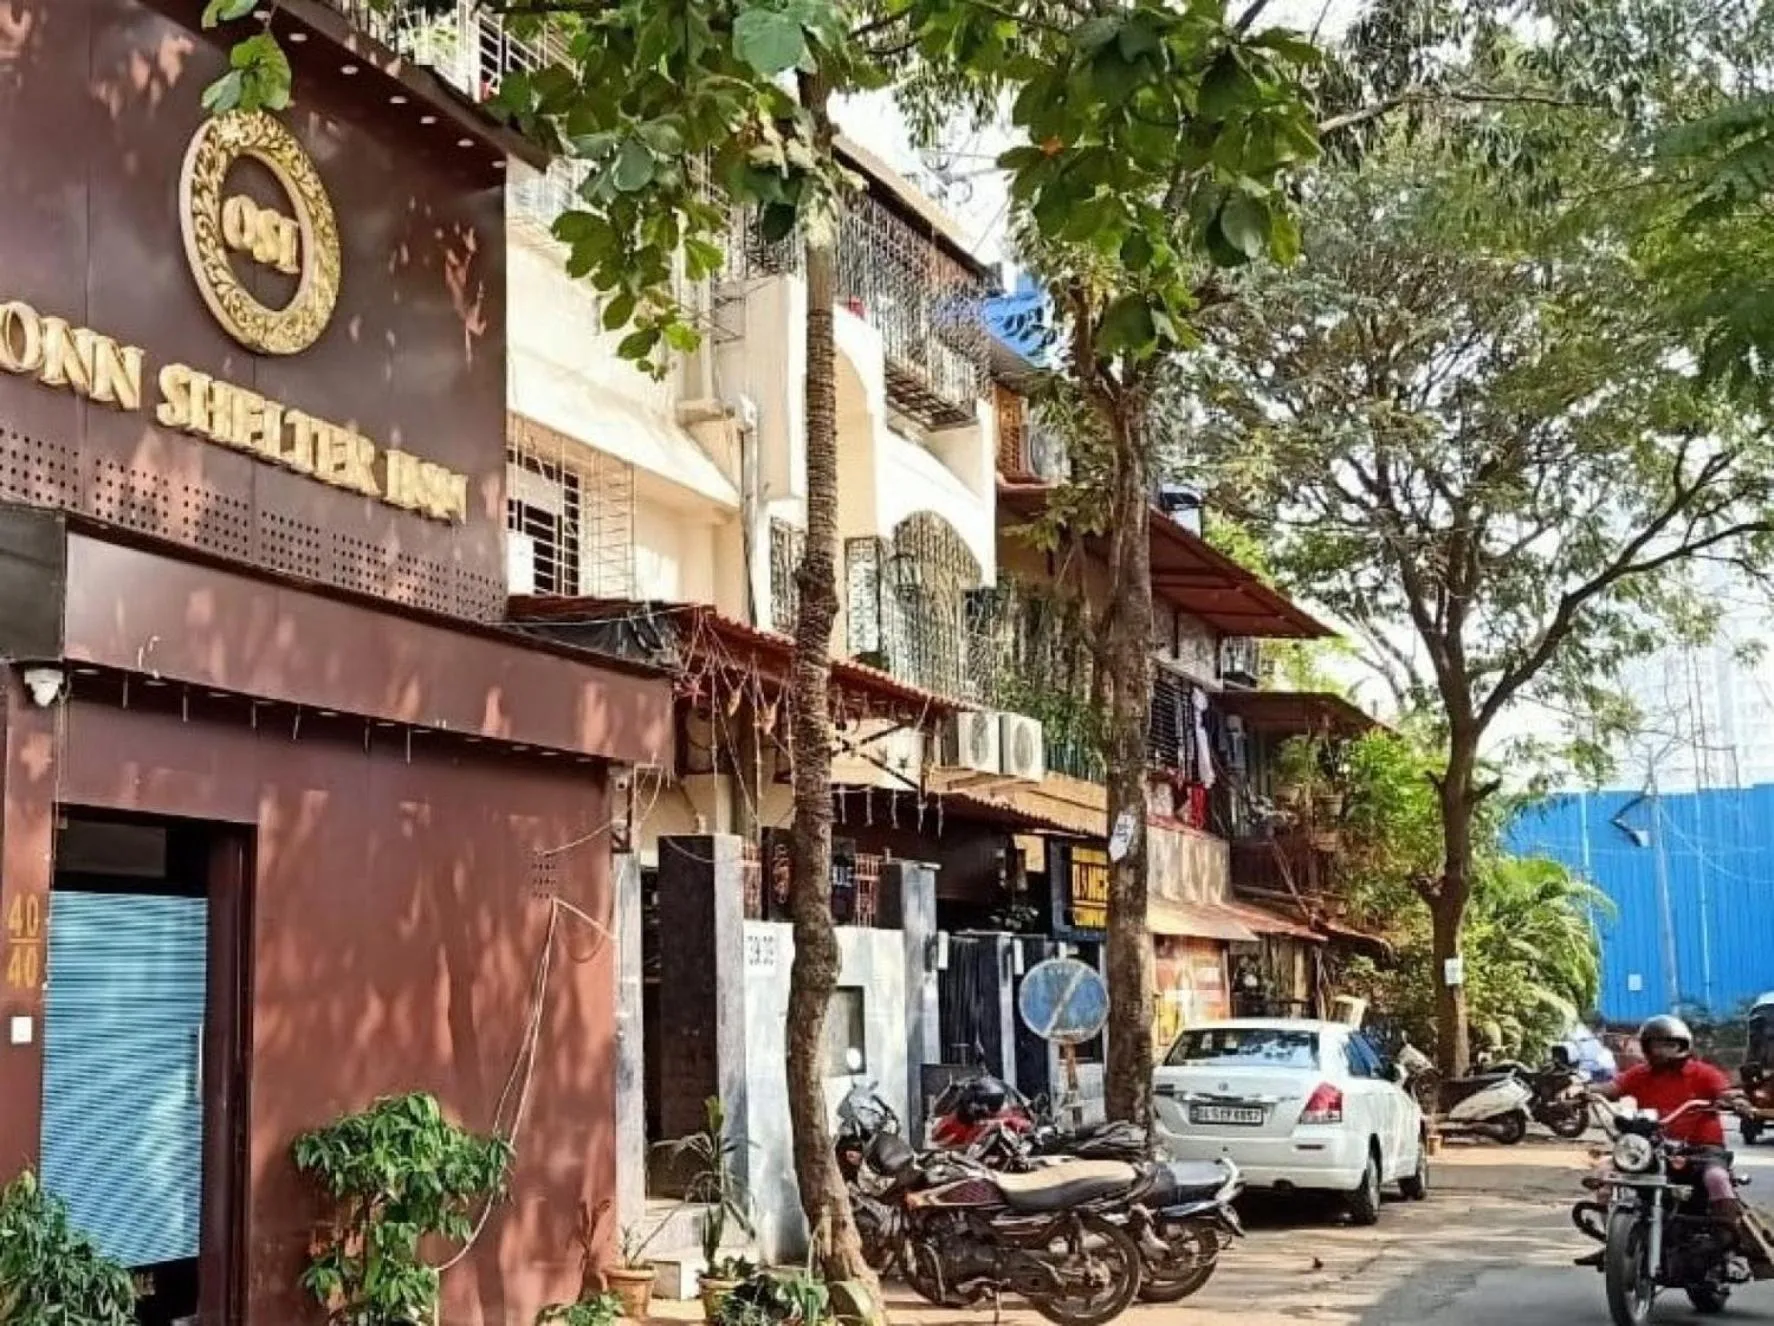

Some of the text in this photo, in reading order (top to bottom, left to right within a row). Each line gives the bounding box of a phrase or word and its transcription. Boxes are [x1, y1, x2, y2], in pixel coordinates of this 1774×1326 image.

[222, 194, 300, 274] OSI
[0, 301, 468, 525] ONN SHELTER INN
[8, 893, 40, 937] 40
[7, 944, 39, 988] 40
